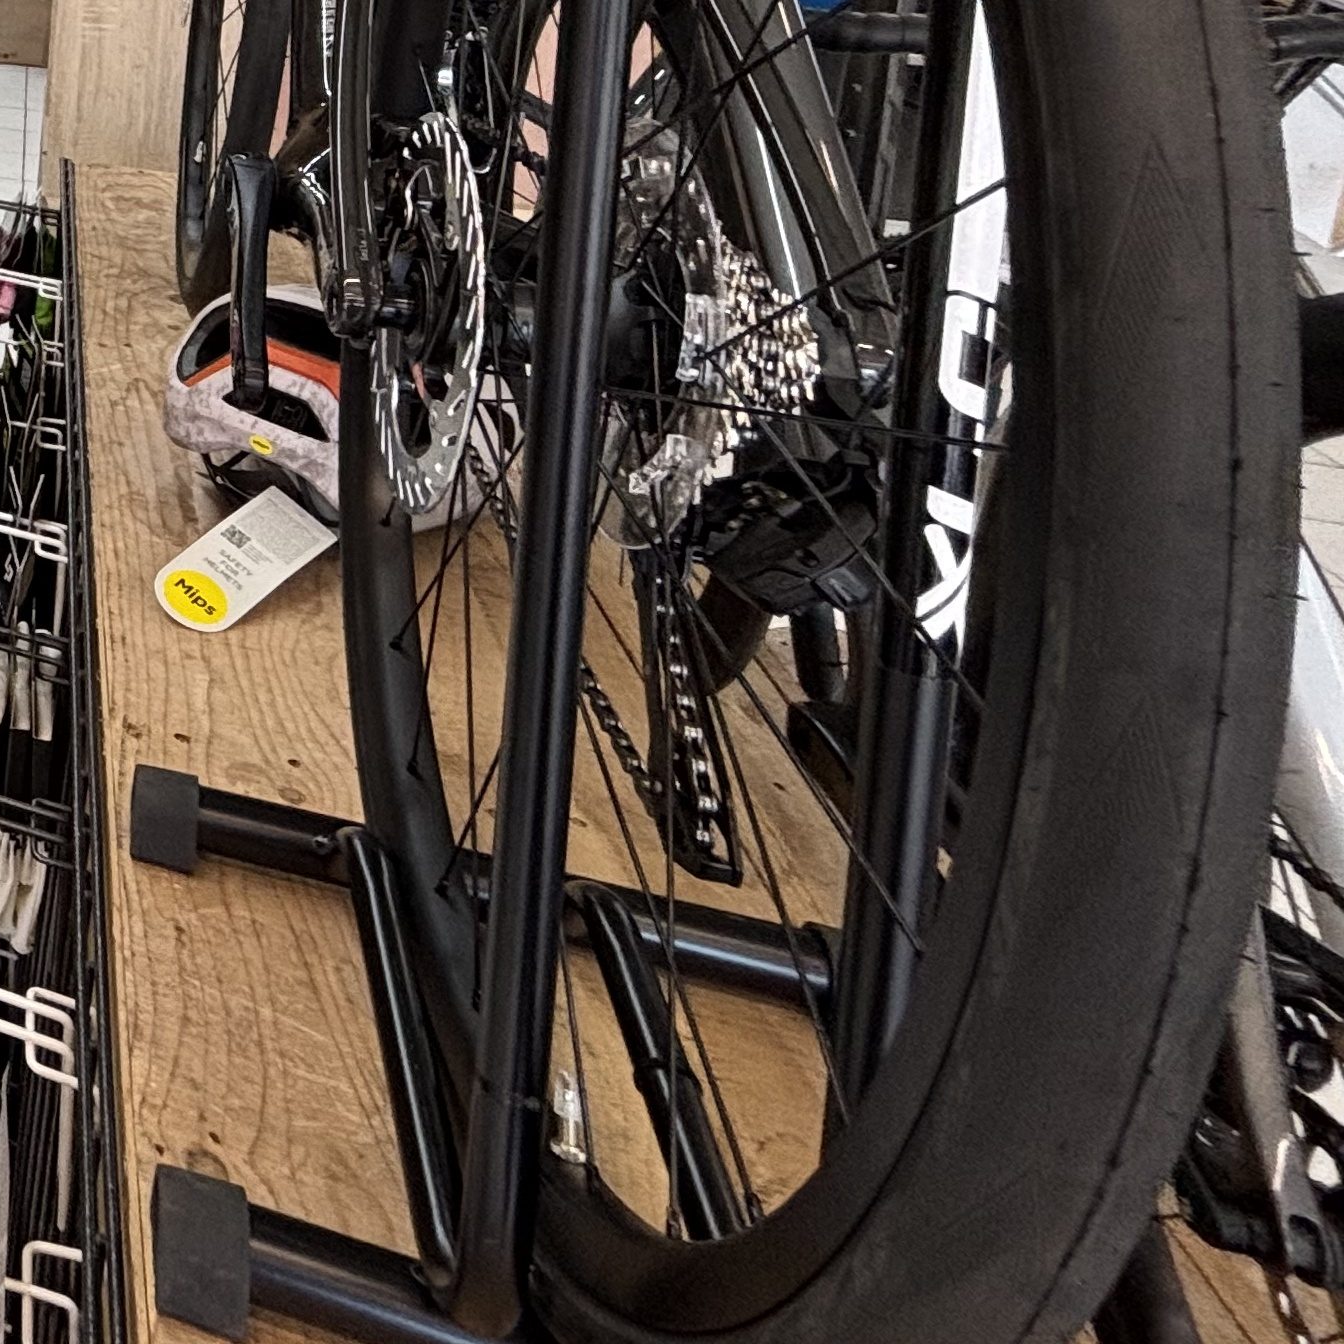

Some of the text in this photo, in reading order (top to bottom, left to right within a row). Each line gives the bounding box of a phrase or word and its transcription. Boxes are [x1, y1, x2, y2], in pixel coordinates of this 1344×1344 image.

[204, 557, 243, 591] HELMETS
[218, 549, 253, 577] SAFETY
[219, 560, 240, 577] FOR
[173, 577, 217, 616] Mips
